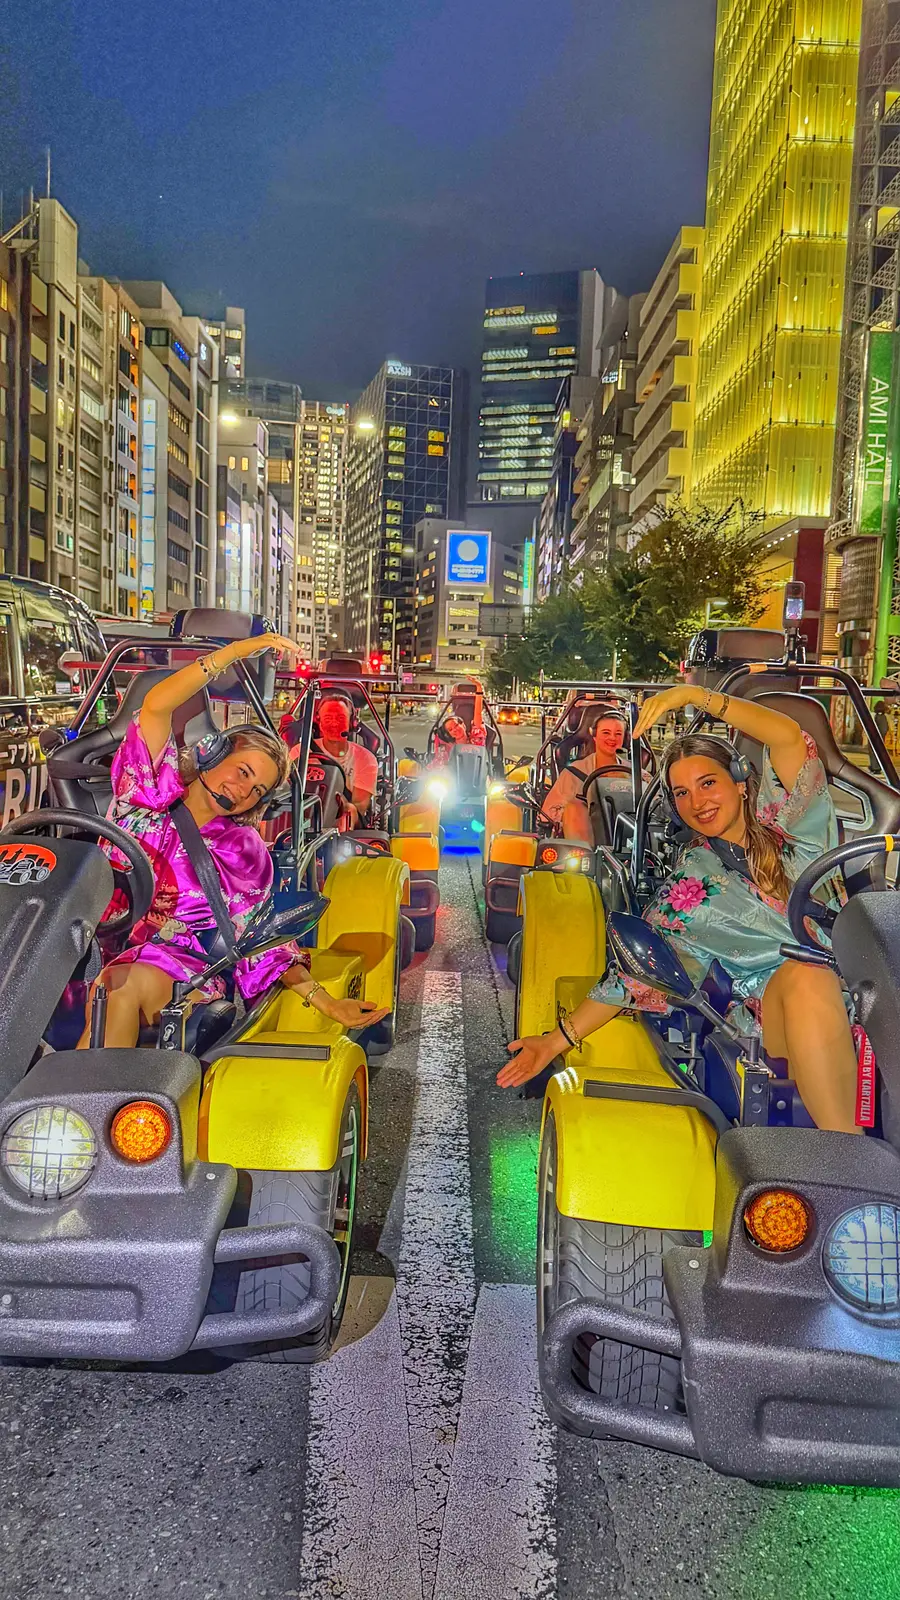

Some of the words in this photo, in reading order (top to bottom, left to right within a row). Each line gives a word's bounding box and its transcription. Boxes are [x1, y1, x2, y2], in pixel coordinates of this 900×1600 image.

[868, 376, 890, 424] AMI
[863, 432, 887, 492] HALL
[862, 1066, 872, 1079] BY
[859, 1079, 872, 1121] KARTZILLA
